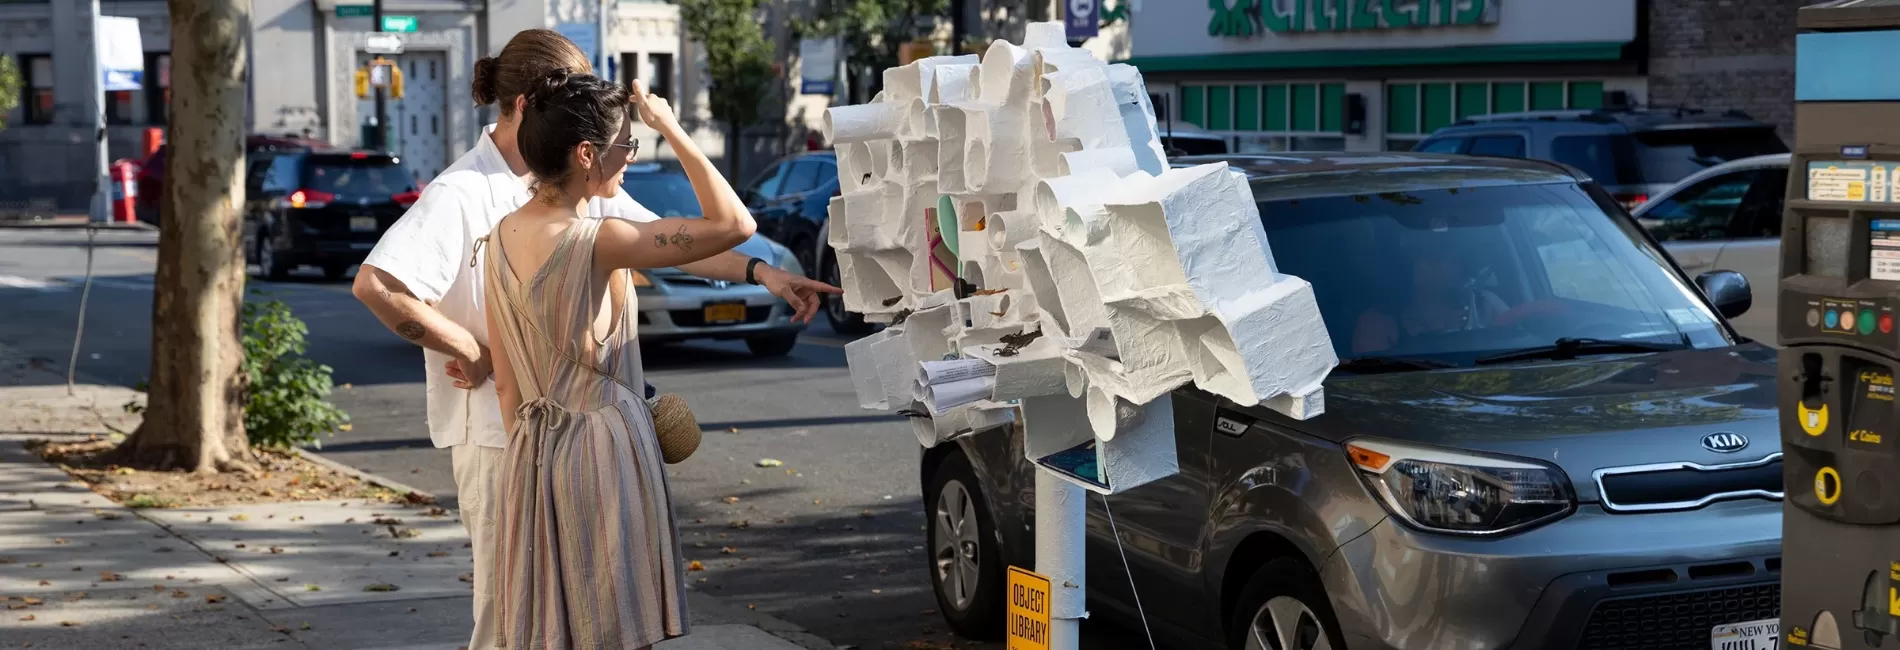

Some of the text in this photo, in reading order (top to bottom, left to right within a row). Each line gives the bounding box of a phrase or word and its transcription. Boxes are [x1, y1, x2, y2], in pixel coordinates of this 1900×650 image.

[1708, 434, 1743, 448] KIA
[1013, 583, 1045, 614] OBJECT
[1011, 612, 1047, 646] LIBRARY
[1740, 623, 1780, 638] NEW YO
